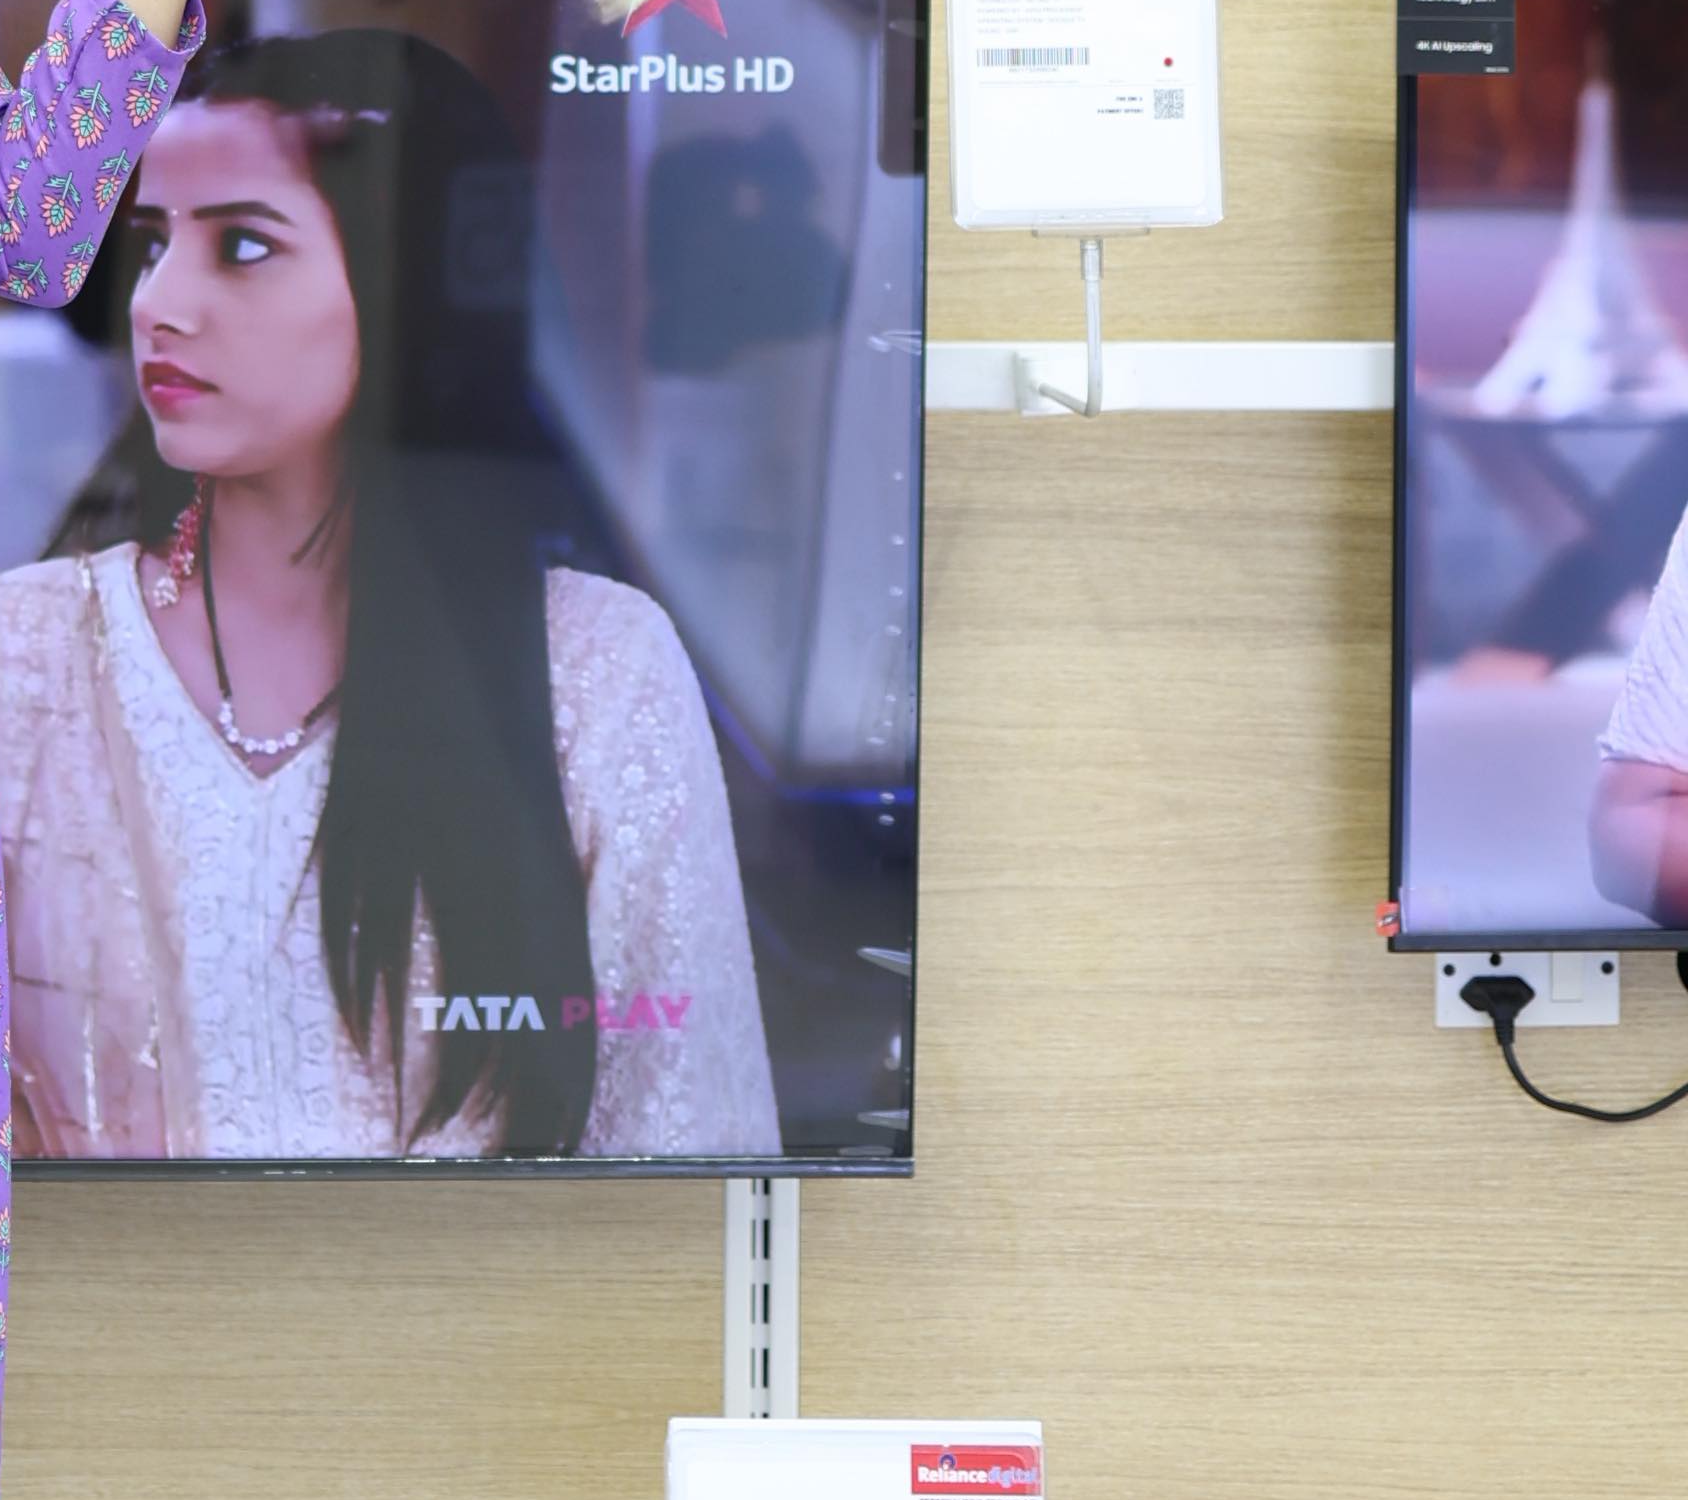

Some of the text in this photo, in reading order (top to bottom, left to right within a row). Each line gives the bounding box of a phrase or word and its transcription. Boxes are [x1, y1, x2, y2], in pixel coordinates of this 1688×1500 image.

[550, 54, 794, 94] StarPlus HD
[413, 993, 692, 1031] TATA PLAY
